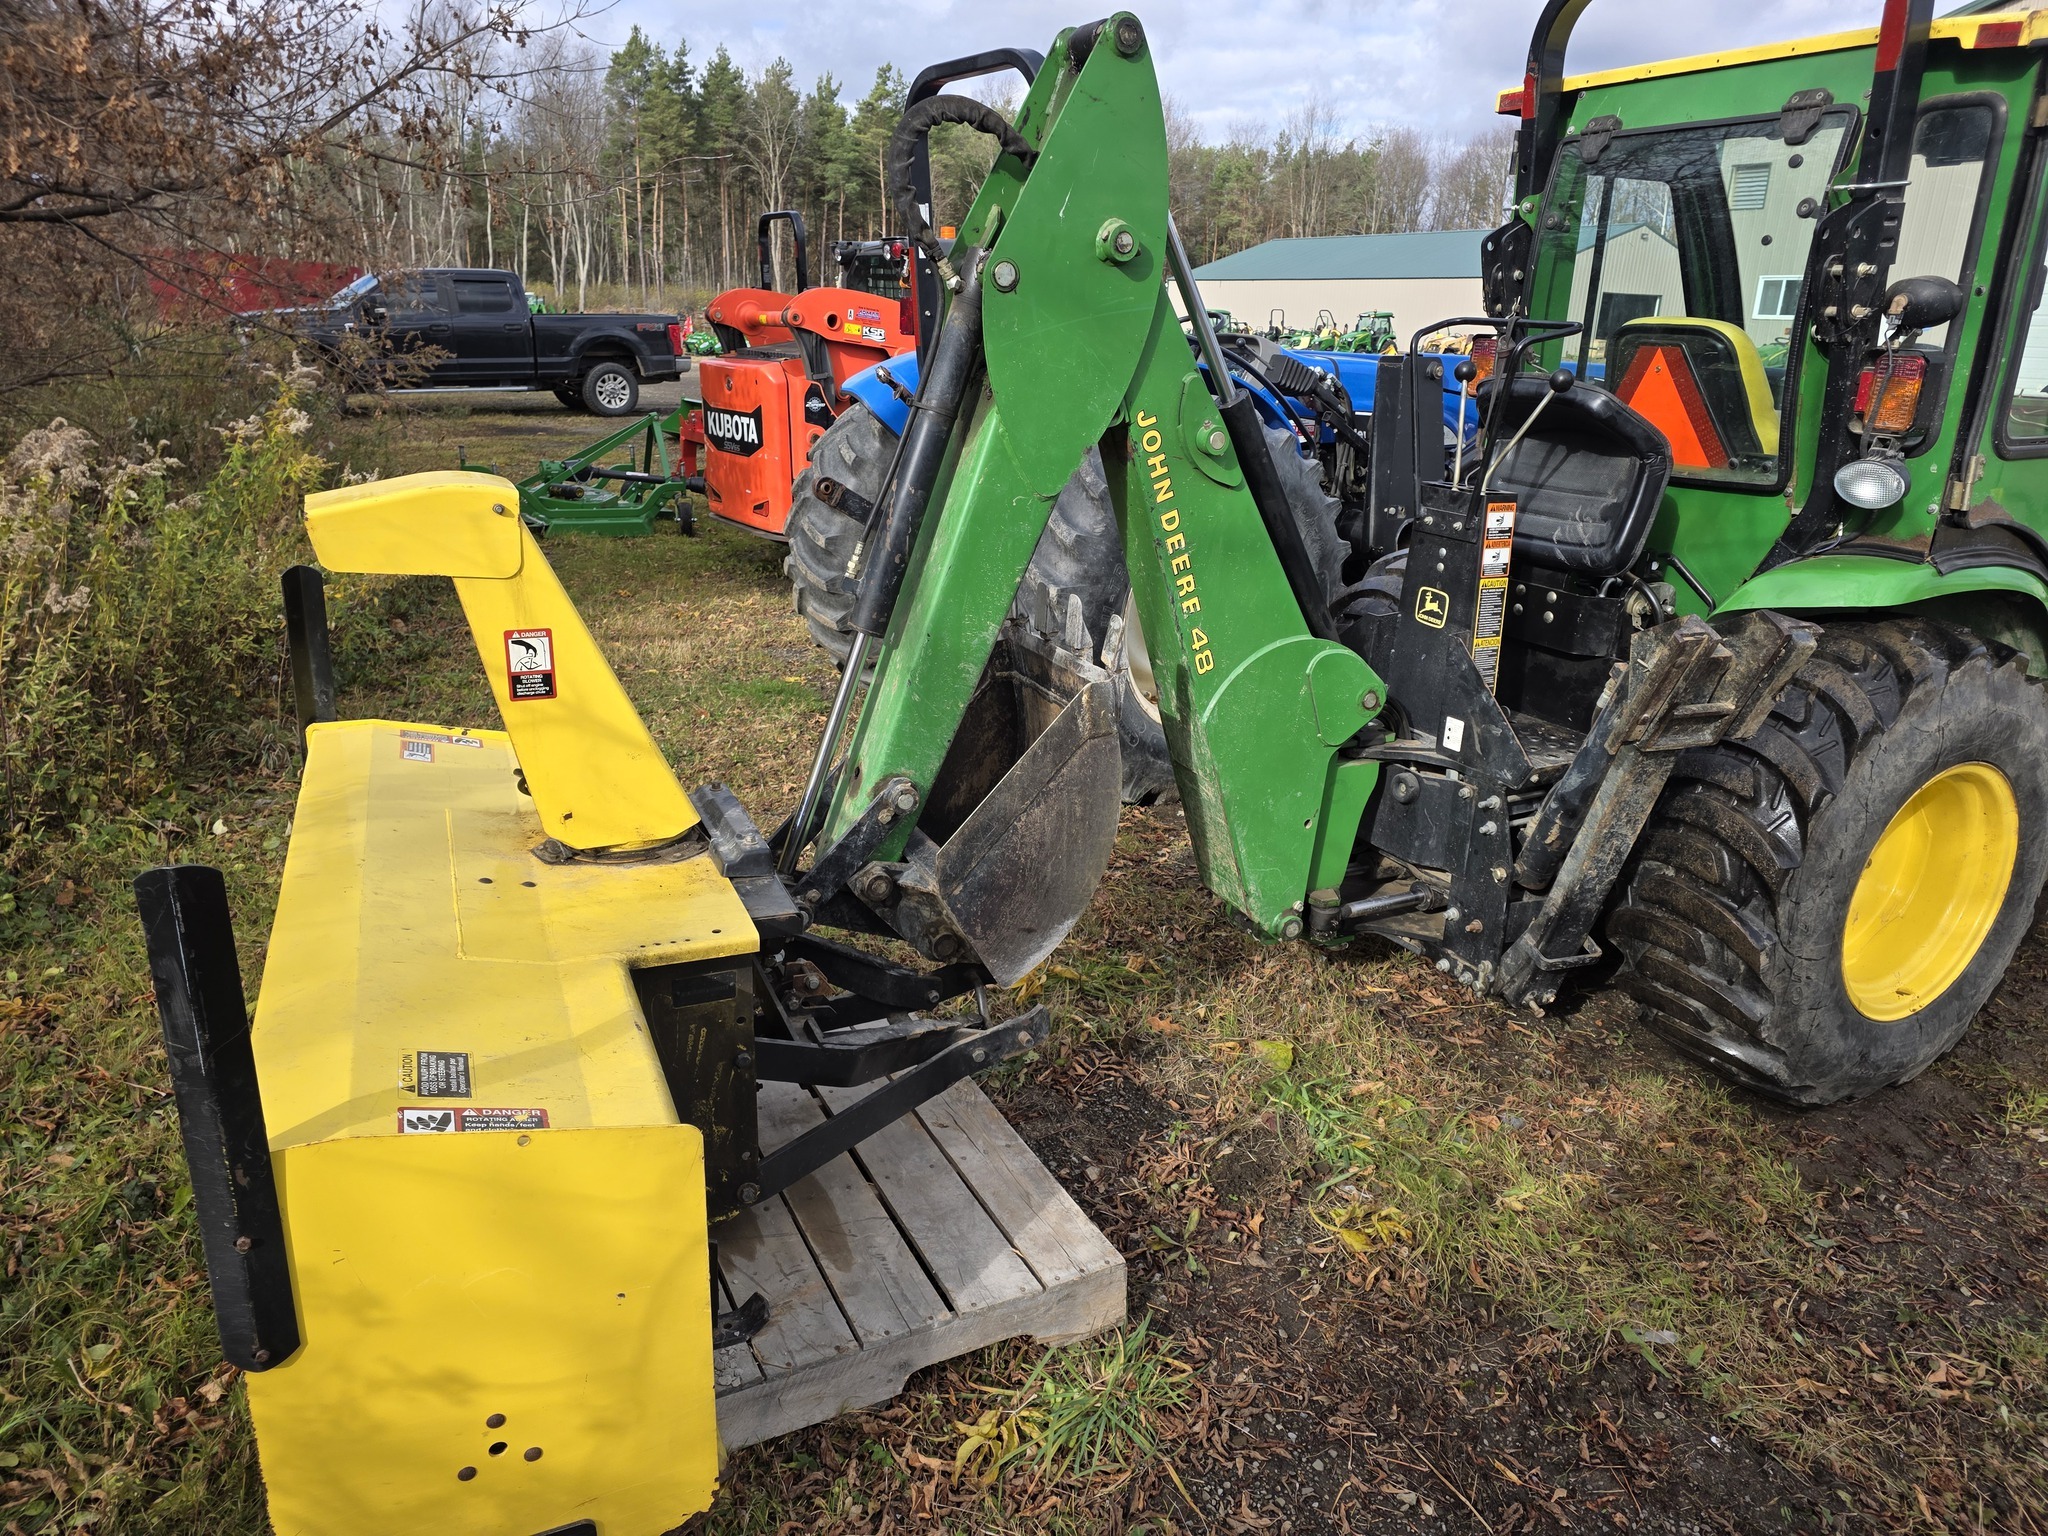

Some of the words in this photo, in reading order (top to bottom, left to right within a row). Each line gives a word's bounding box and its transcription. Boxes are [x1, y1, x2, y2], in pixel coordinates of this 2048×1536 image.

[862, 326, 886, 337] KSR
[707, 410, 759, 444] KUBOTA
[1495, 504, 1515, 512] WARNING
[1136, 410, 1175, 504] JOHN
[1159, 508, 1202, 620] DEERE
[1190, 627, 1215, 676] 48
[1486, 580, 1507, 588] CAUTION
[420, 1053, 428, 1065] FROM
[428, 1054, 437, 1074] BRAKING
[449, 1057, 457, 1065] per
[456, 1056, 465, 1071] Manual
[402, 1053, 413, 1083] CAUTION
[420, 1066, 428, 1081] INJURY
[438, 1059, 446, 1081] STEERING
[449, 1065, 457, 1078] ballast
[429, 1074, 437, 1082] OF
[458, 1072, 468, 1094] Operator's
[420, 1082, 429, 1095] AVOID
[429, 1081, 438, 1094] LOSS
[449, 1079, 457, 1092] Install
